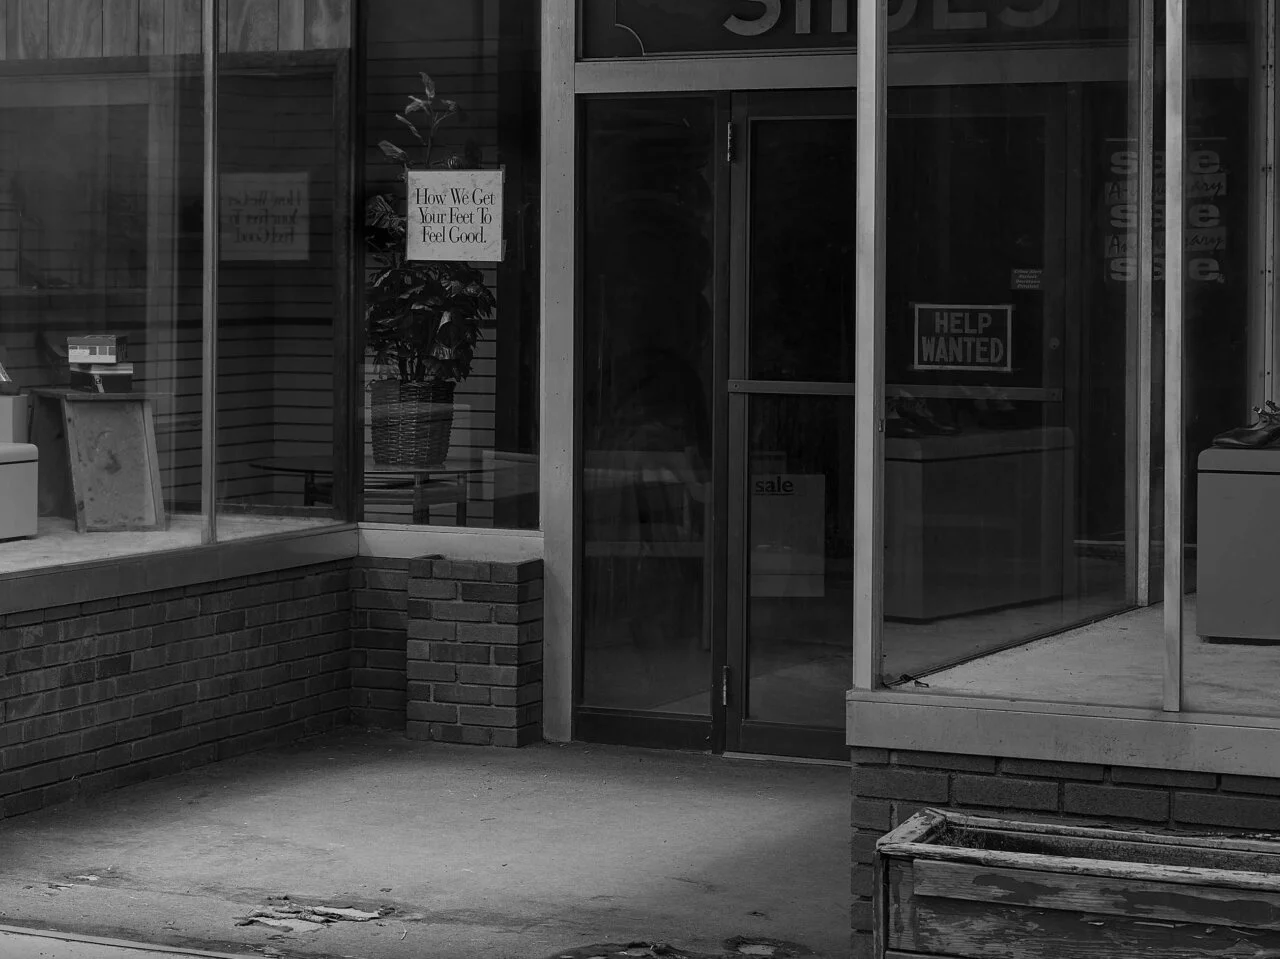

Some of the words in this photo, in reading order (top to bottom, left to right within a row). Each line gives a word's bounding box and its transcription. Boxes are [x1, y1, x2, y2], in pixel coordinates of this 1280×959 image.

[415, 187, 447, 205] How
[449, 187, 470, 205] We
[472, 187, 495, 205] Get
[418, 206, 447, 224] Your
[449, 206, 475, 224] Feet
[477, 206, 493, 224] To
[422, 225, 446, 242] Feel
[448, 225, 487, 243] Good.
[934, 311, 993, 334] HELP
[921, 335, 1005, 364] WANTED
[755, 476, 794, 494] sale
